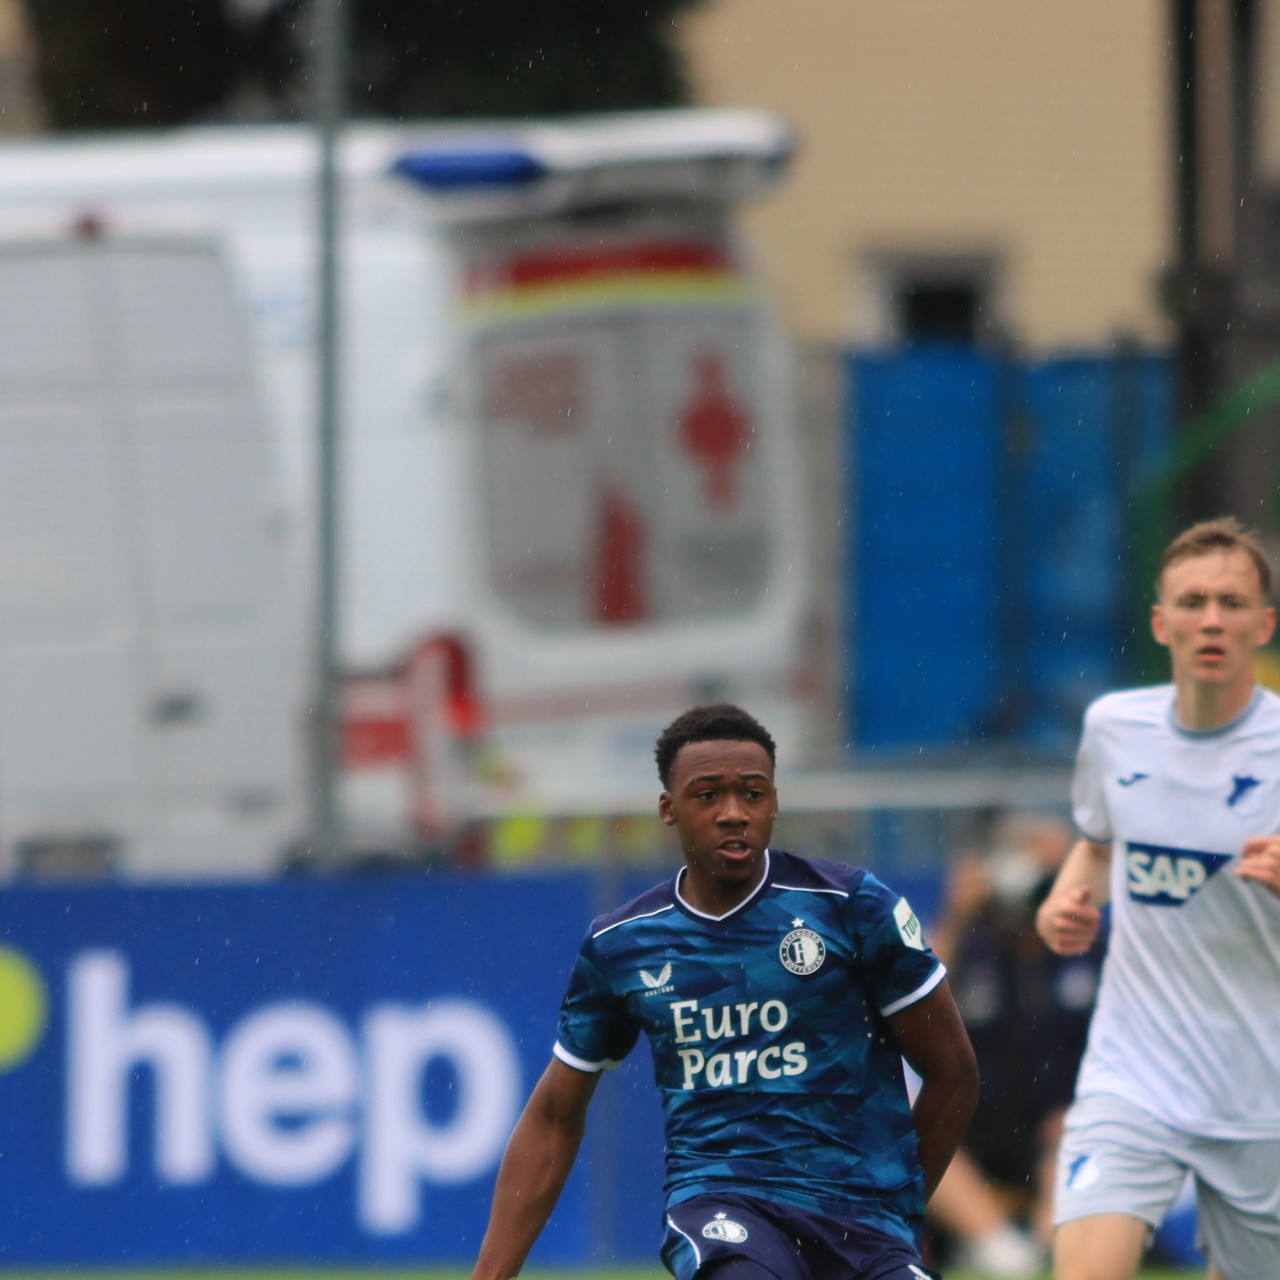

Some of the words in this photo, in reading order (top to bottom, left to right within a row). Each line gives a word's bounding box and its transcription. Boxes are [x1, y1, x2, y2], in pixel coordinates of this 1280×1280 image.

[1128, 852, 1206, 898] SAP
[670, 1000, 788, 1044] Euro
[677, 1042, 808, 1090] Parcs
[66, 950, 518, 1233] hep
